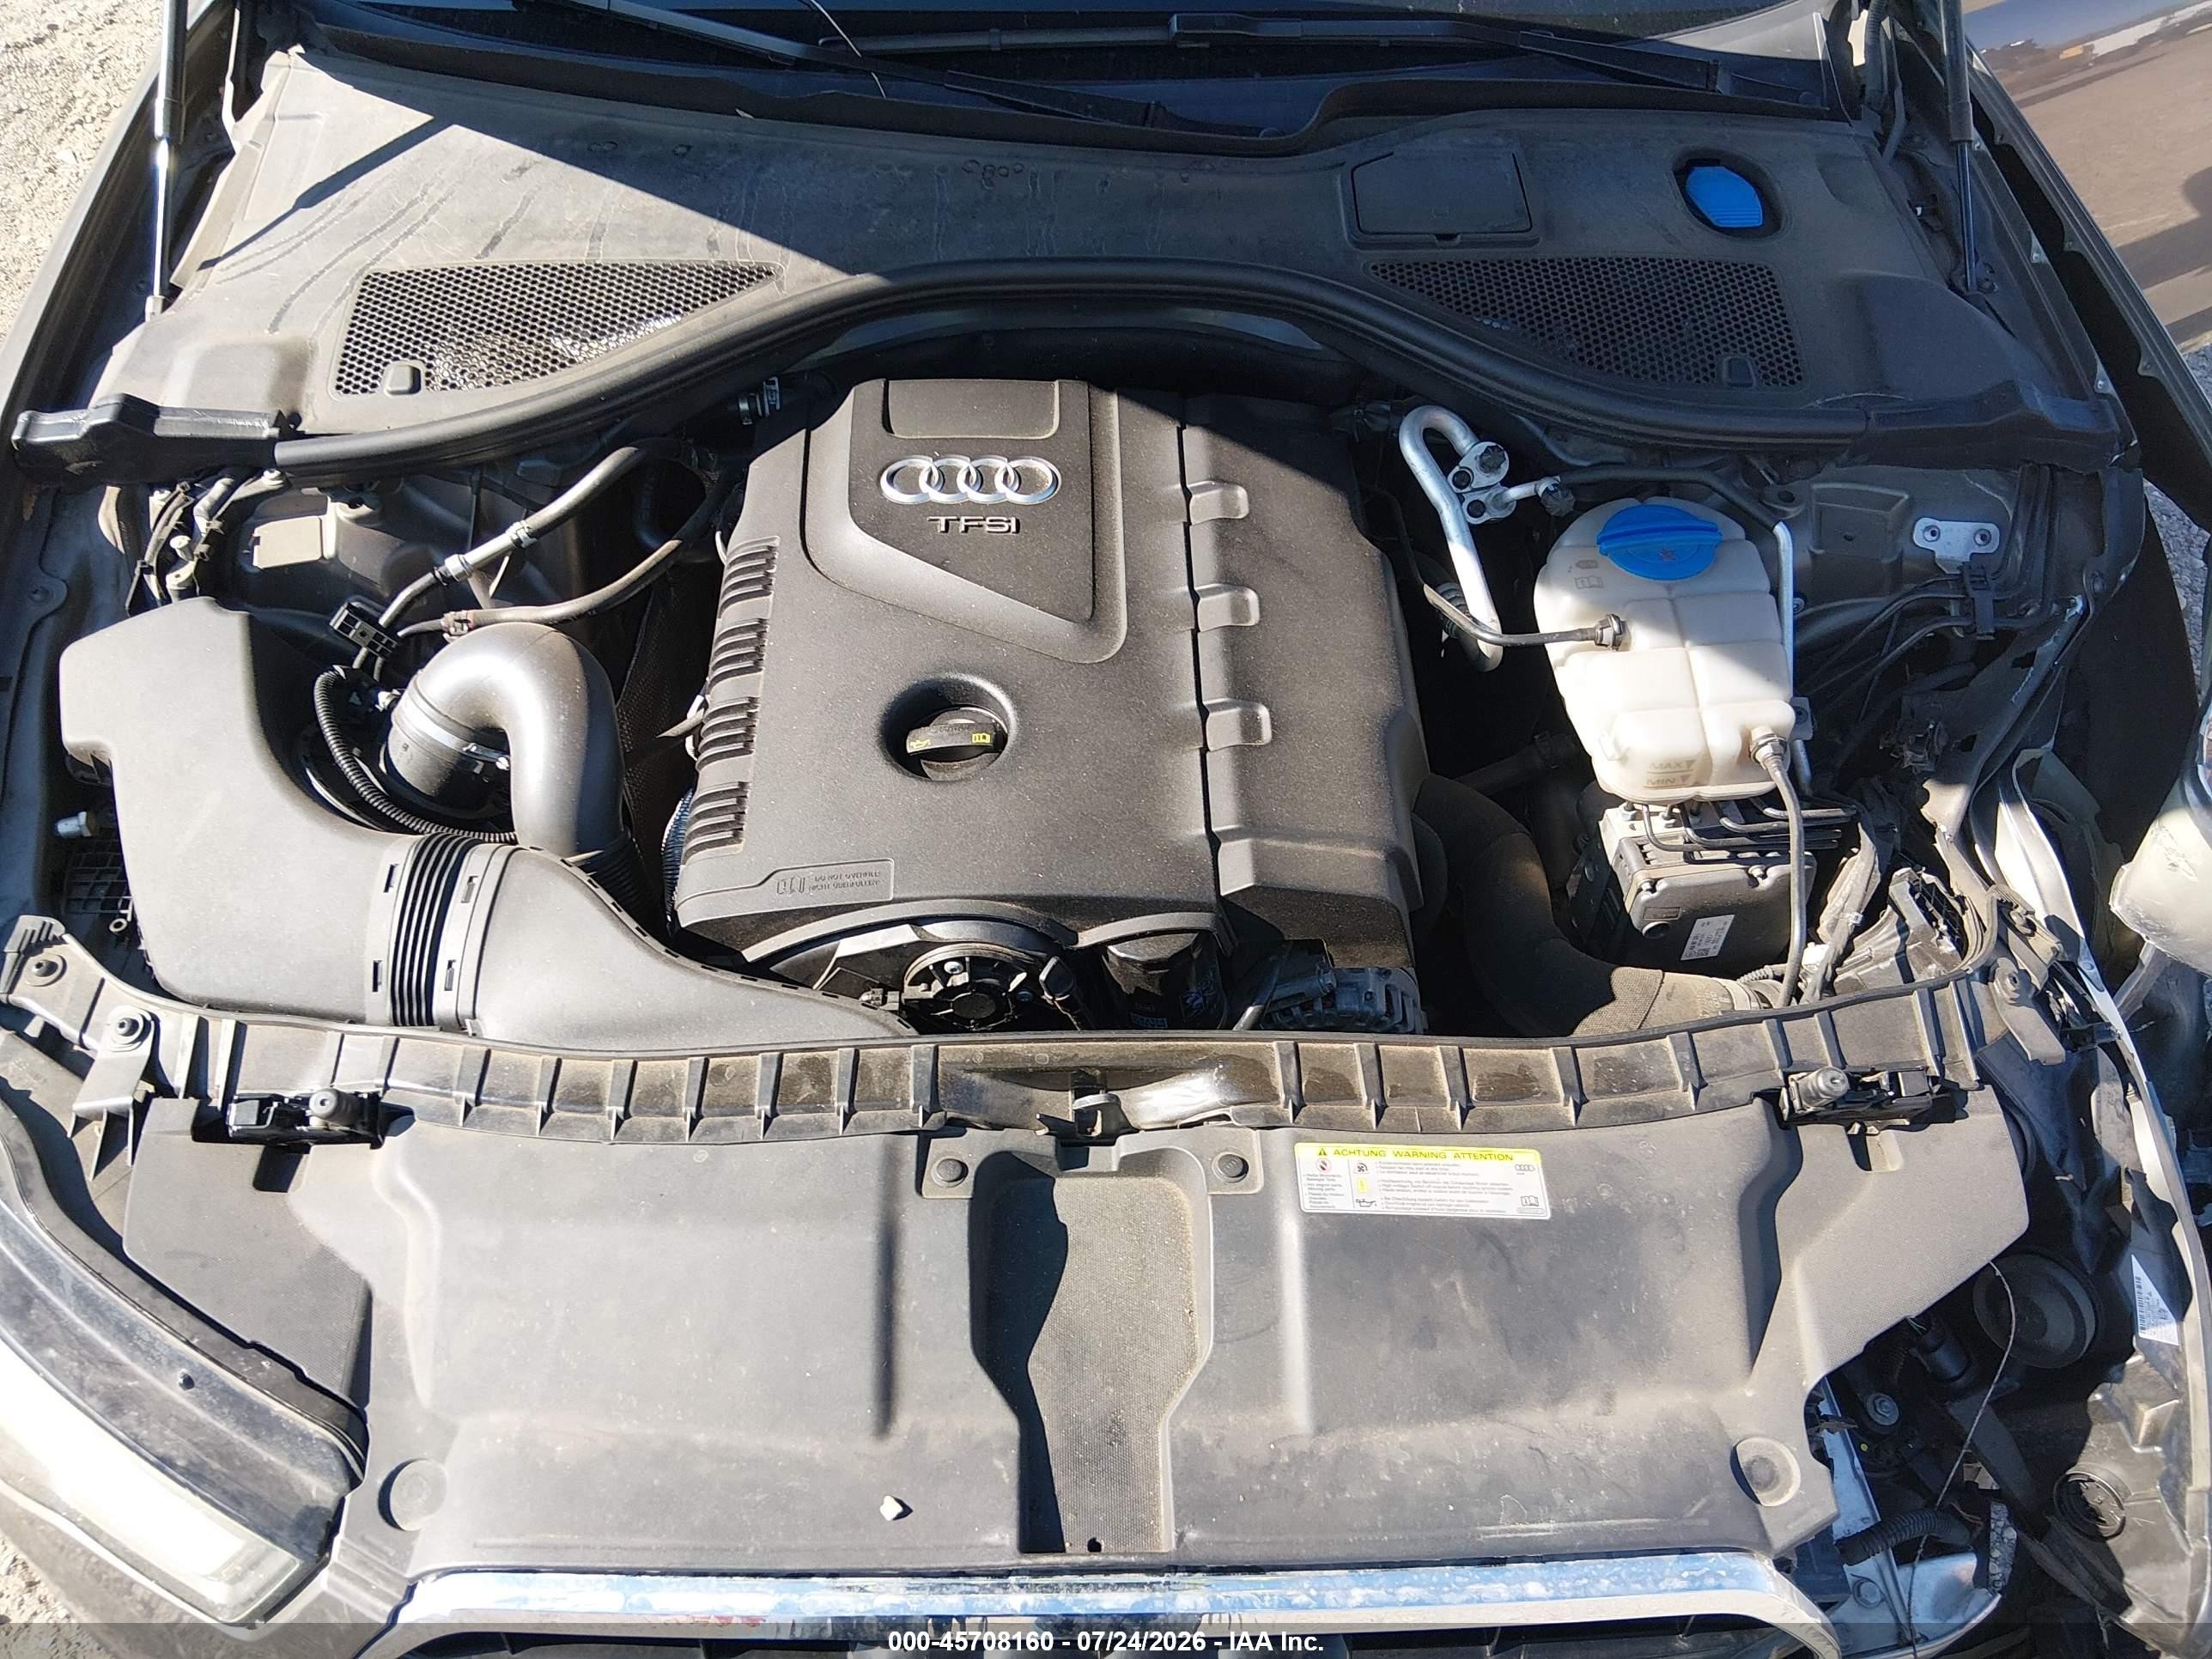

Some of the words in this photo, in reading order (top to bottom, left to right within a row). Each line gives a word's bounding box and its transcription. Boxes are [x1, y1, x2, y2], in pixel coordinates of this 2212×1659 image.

[927, 515, 1019, 533] TFSI
[1333, 1148, 1386, 1158] ACHTUNG
[1392, 1151, 1447, 1159] WARNING
[1454, 1152, 1514, 1161] ATTENTION
